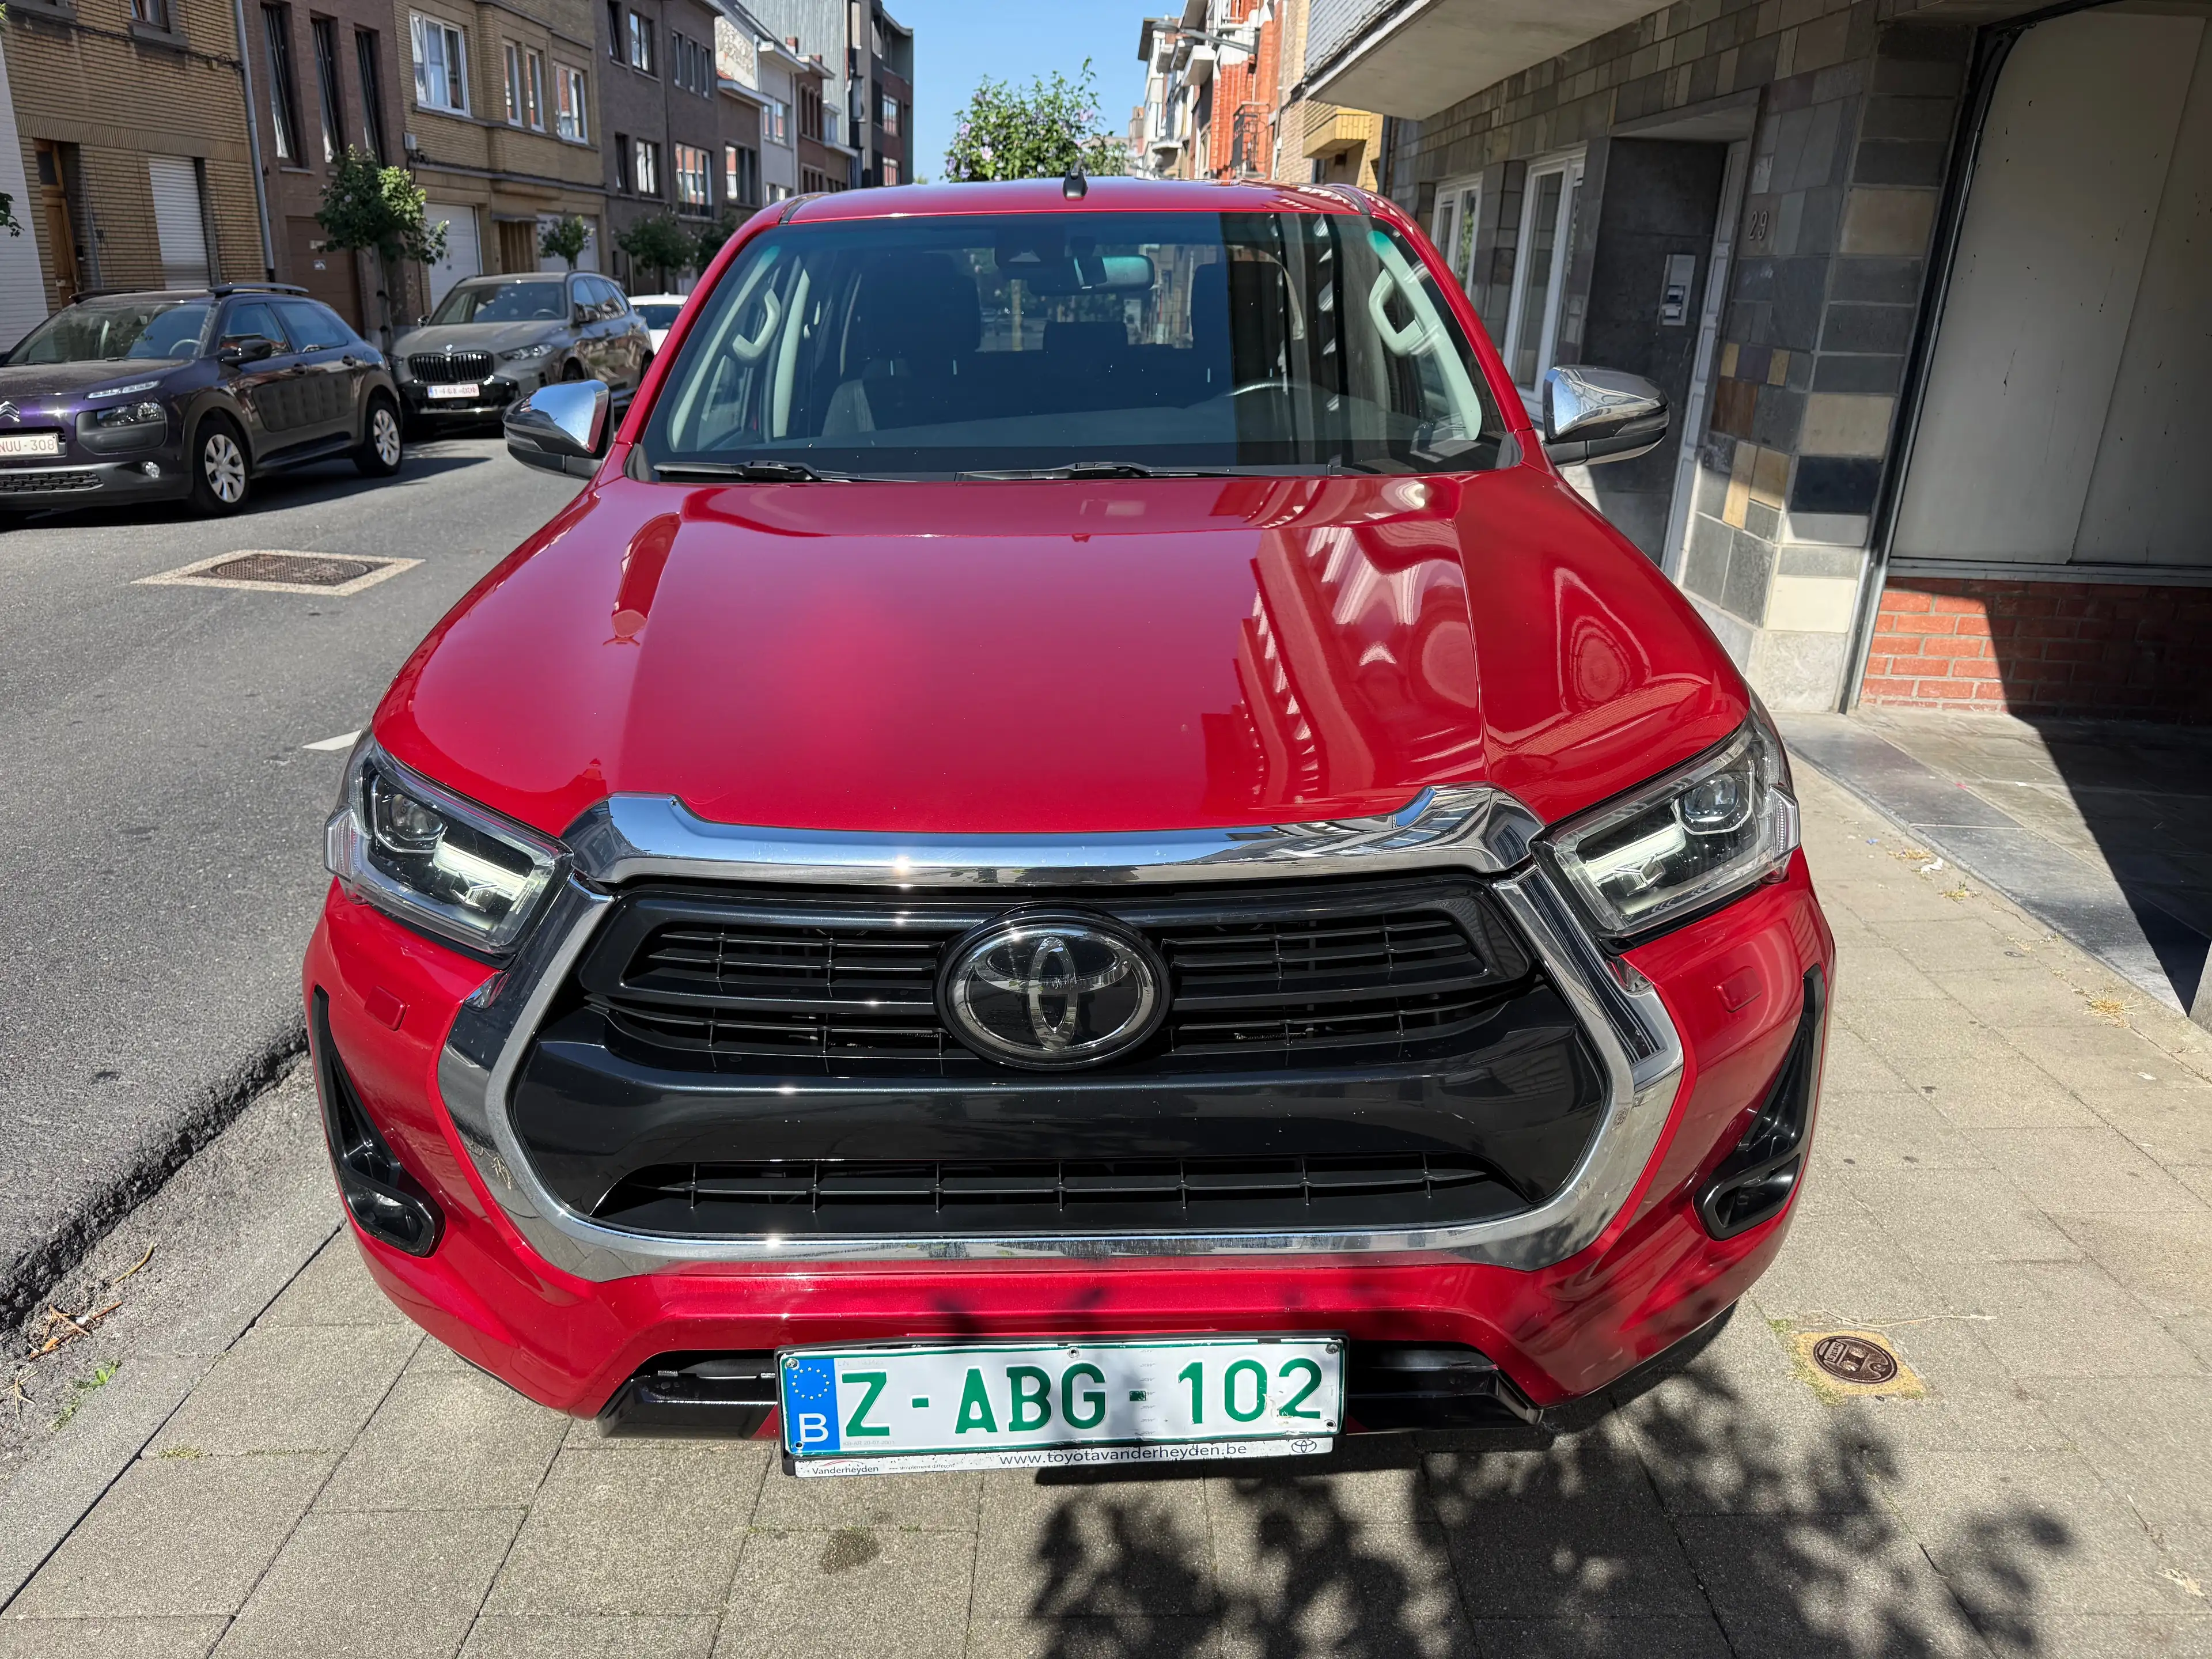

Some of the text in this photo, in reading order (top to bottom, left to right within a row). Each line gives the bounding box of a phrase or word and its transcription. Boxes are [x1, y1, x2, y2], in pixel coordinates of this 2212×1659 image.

[1749, 210, 1769, 240] 29
[798, 1413, 829, 1442] B
[999, 1445, 1248, 1465] www.toyotavanderheyden.be
[812, 1465, 879, 1475] Vanderheyden
